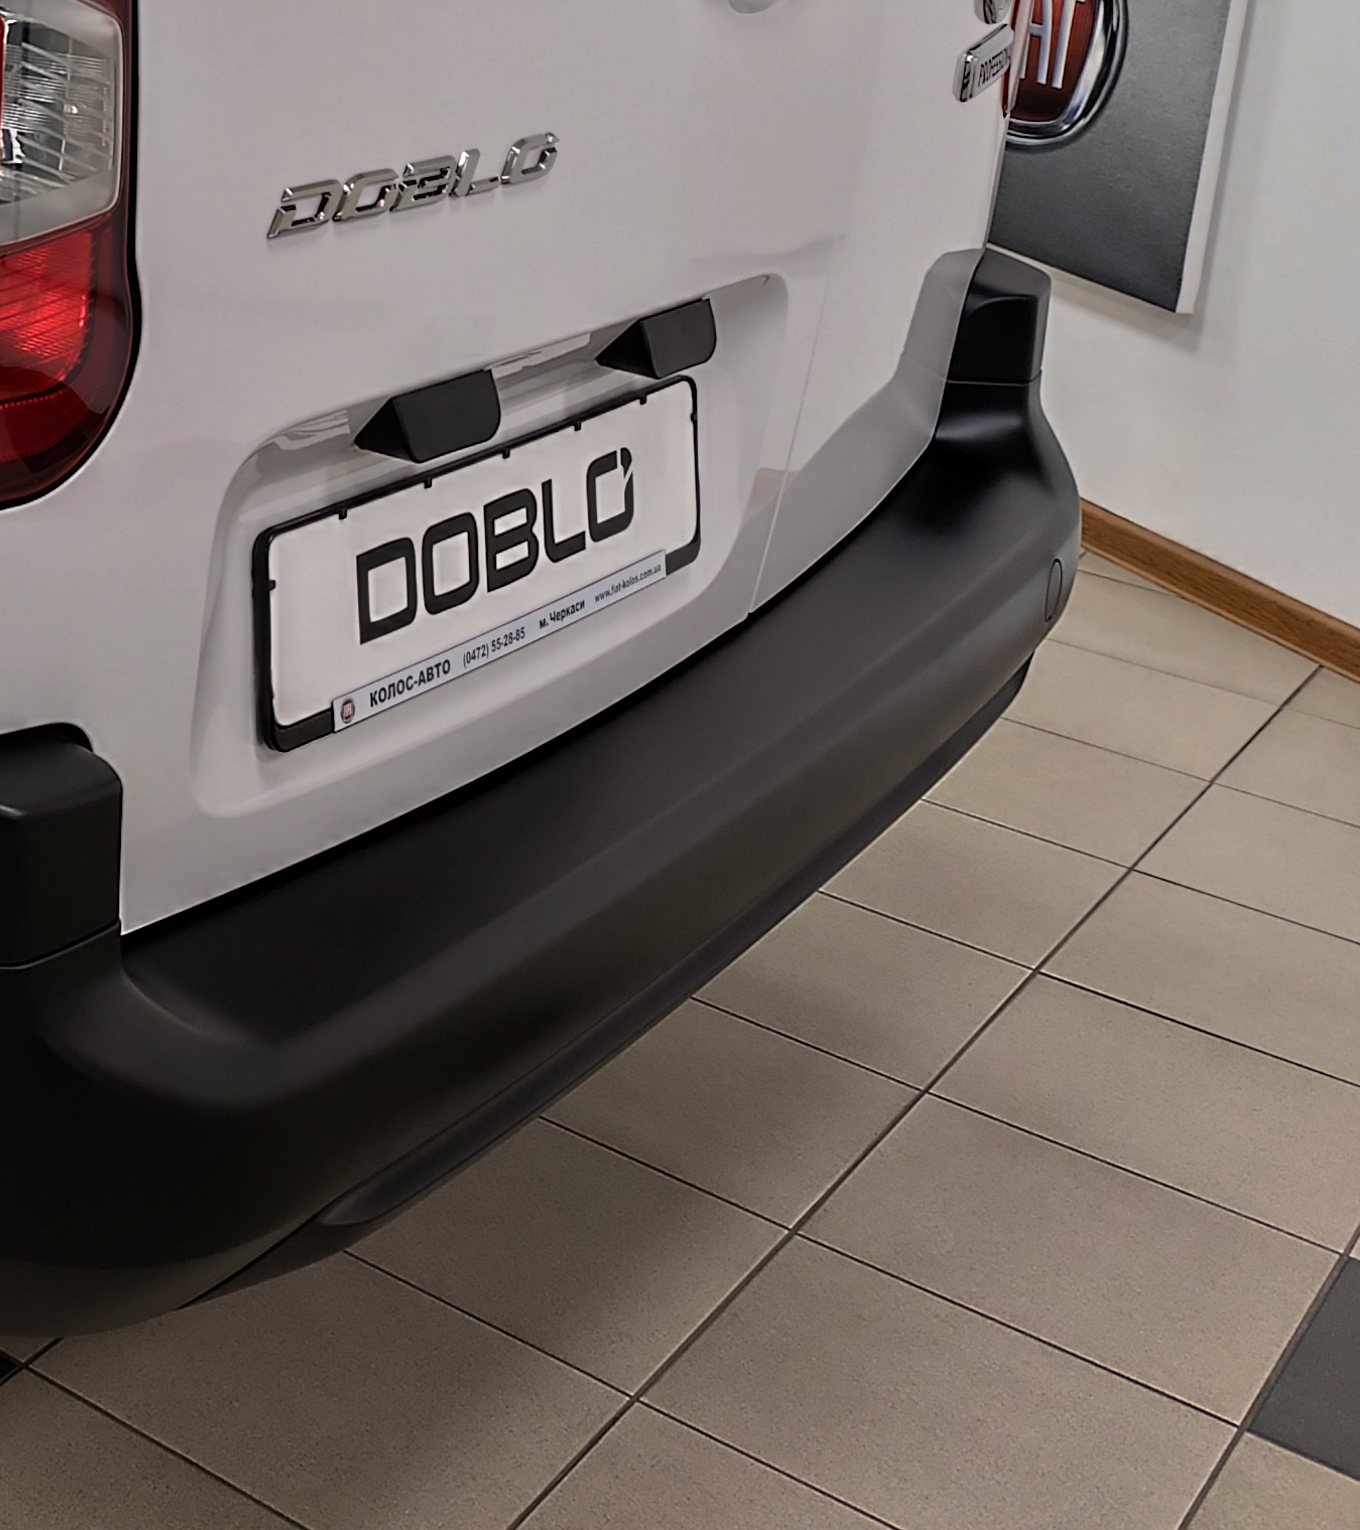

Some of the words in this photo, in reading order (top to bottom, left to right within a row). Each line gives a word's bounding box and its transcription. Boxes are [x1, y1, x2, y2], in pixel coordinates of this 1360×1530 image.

[266, 131, 561, 240] DOBLO
[355, 446, 635, 646] DOBLO
[369, 658, 452, 708] КОЛОС-АВТО
[462, 643, 491, 670] (0472)
[490, 626, 526, 654] 55-28-85
[550, 599, 586, 625] Черкаси
[594, 563, 662, 603] www.fiat-kolos.com.ua
